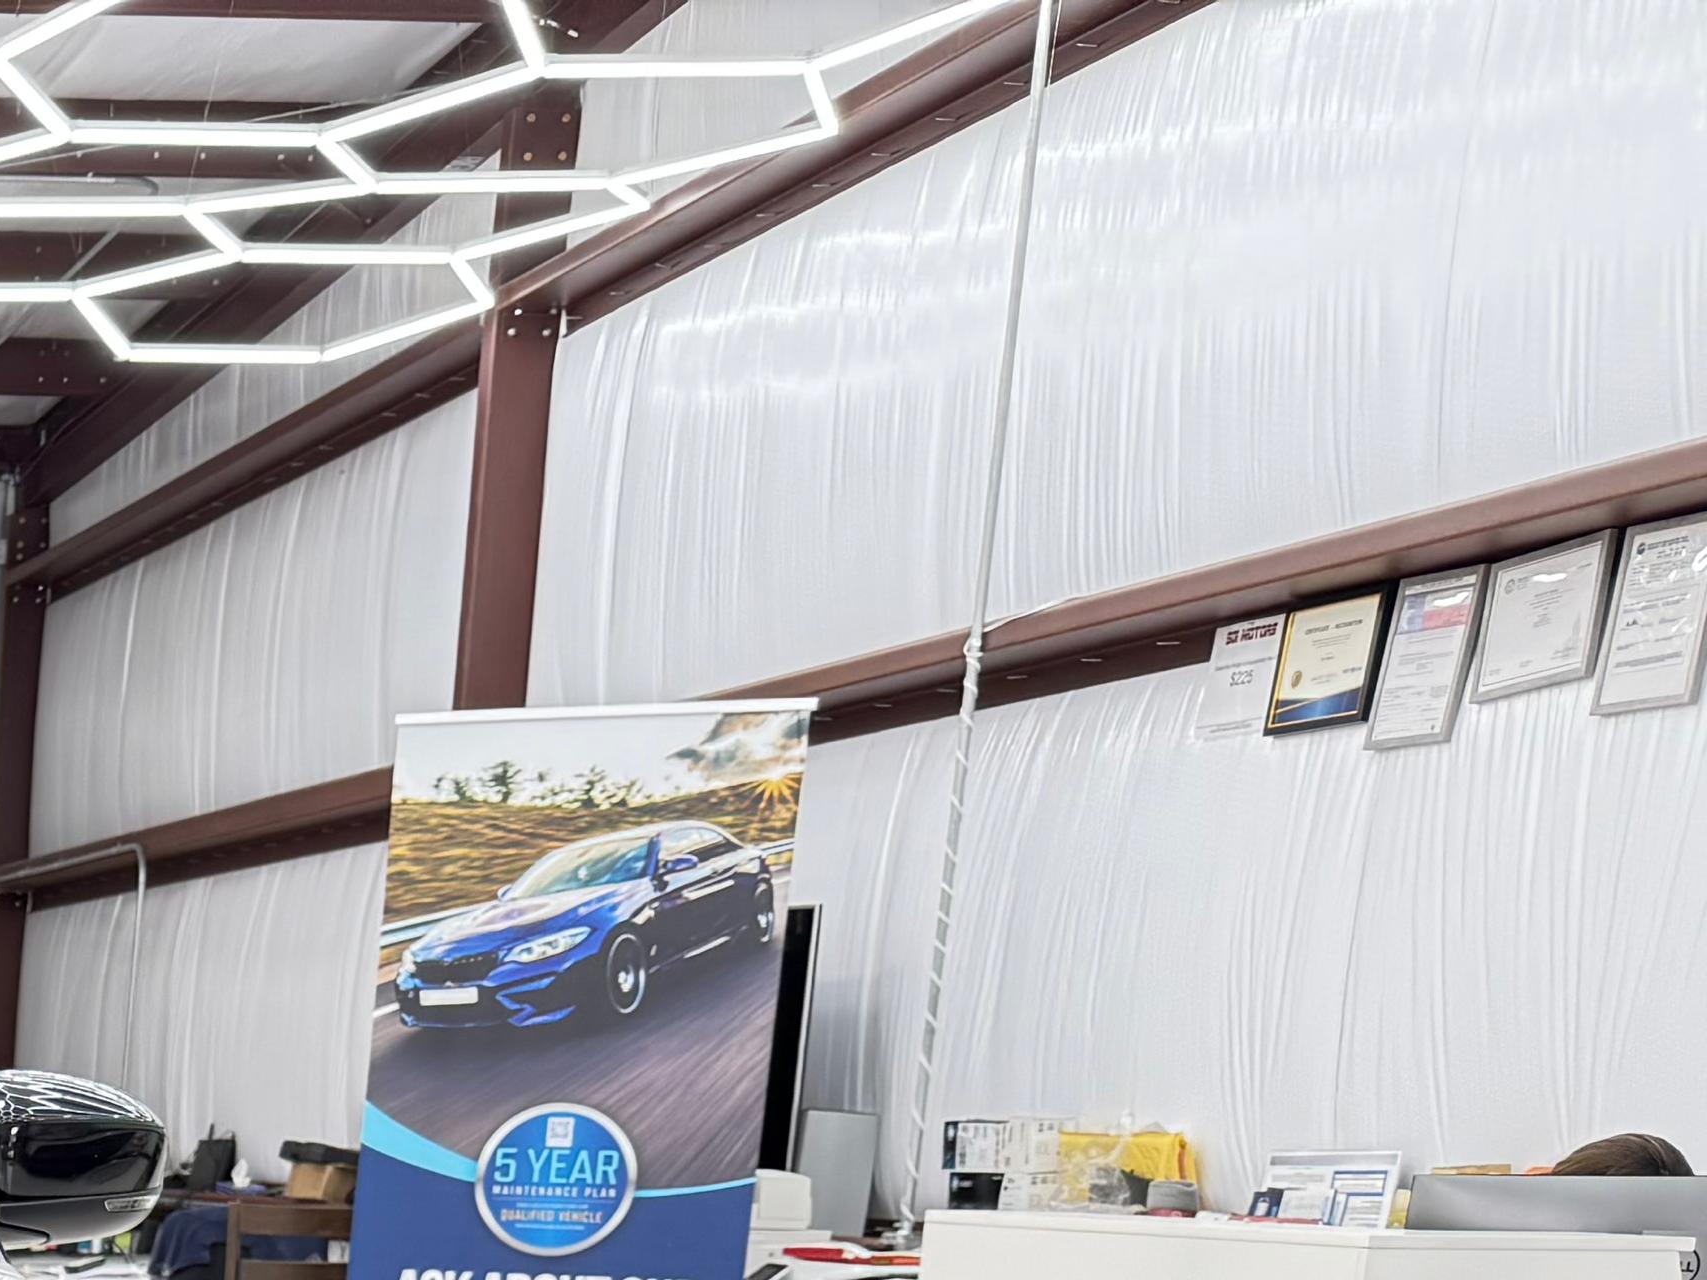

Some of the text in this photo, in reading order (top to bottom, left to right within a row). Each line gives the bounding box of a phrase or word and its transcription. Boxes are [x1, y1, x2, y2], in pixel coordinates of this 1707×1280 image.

[493, 1147, 620, 1185] 5 YEAR
[492, 1184, 617, 1198] MAINTENANCE PLAN
